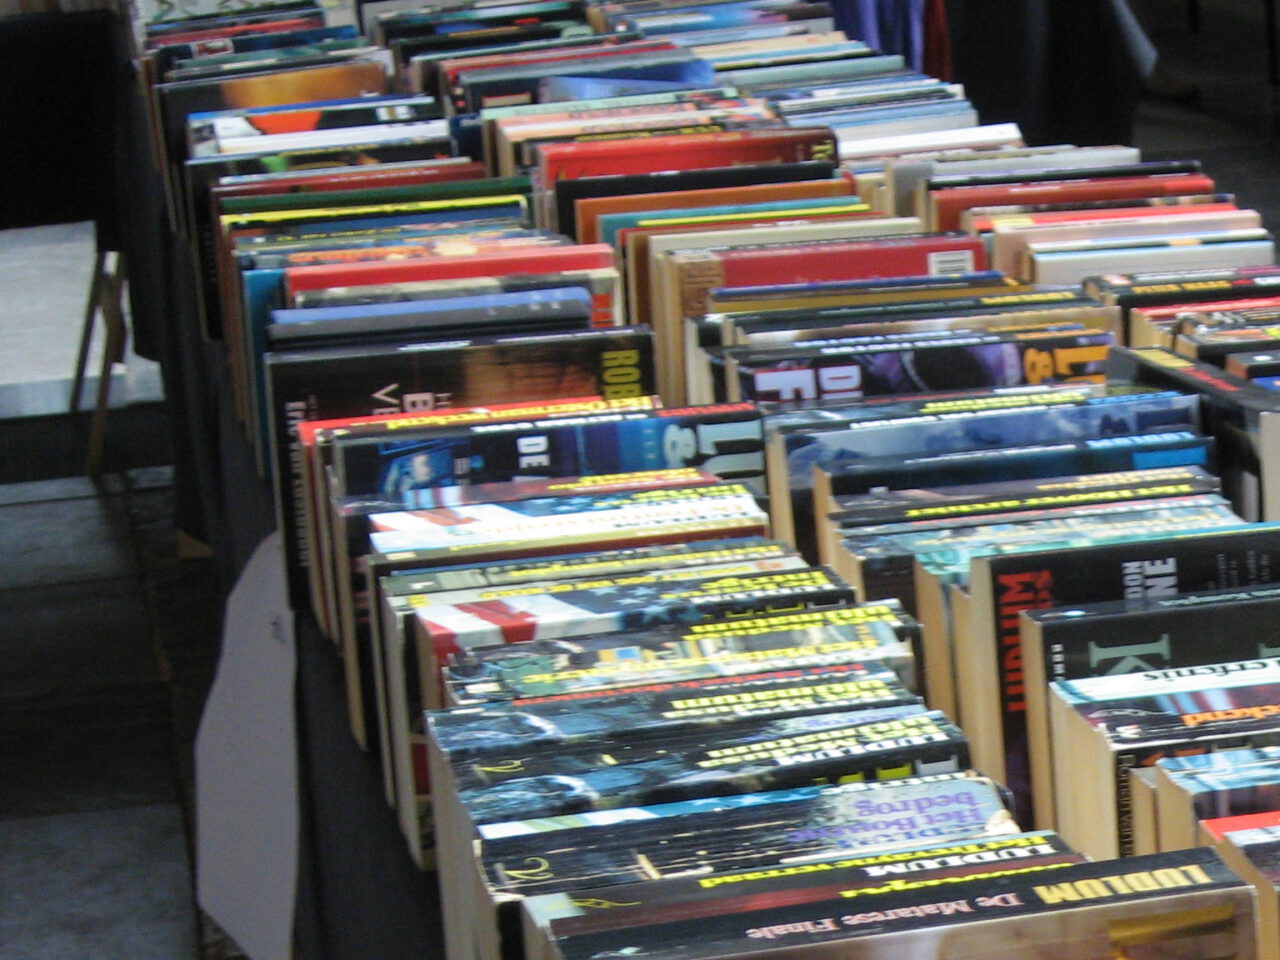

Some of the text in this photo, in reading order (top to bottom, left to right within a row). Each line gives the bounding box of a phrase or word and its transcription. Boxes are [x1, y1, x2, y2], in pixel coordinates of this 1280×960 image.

[600, 350, 643, 399] ROB
[1025, 487, 1134, 508] Hoover
[1137, 483, 1192, 496] Het
[905, 498, 1021, 518] archief
[690, 605, 893, 634] ultimatum
[1142, 656, 1269, 683] erfenis
[512, 684, 674, 707] document
[659, 697, 816, 719] Medusa
[668, 679, 886, 710] ultimatum
[694, 723, 943, 768] Het Medusa
[704, 716, 933, 759] ultimatum
[773, 731, 951, 766] LUDLUM
[852, 791, 976, 818] bedrog
[788, 807, 984, 844] Het Bourne
[697, 859, 844, 889] verraad
[861, 844, 1058, 878] LUDLUM
[1033, 863, 1214, 904] LUDLUM
[840, 898, 971, 928] Matarese
[976, 891, 1026, 909] De
[744, 915, 837, 940] Finale
